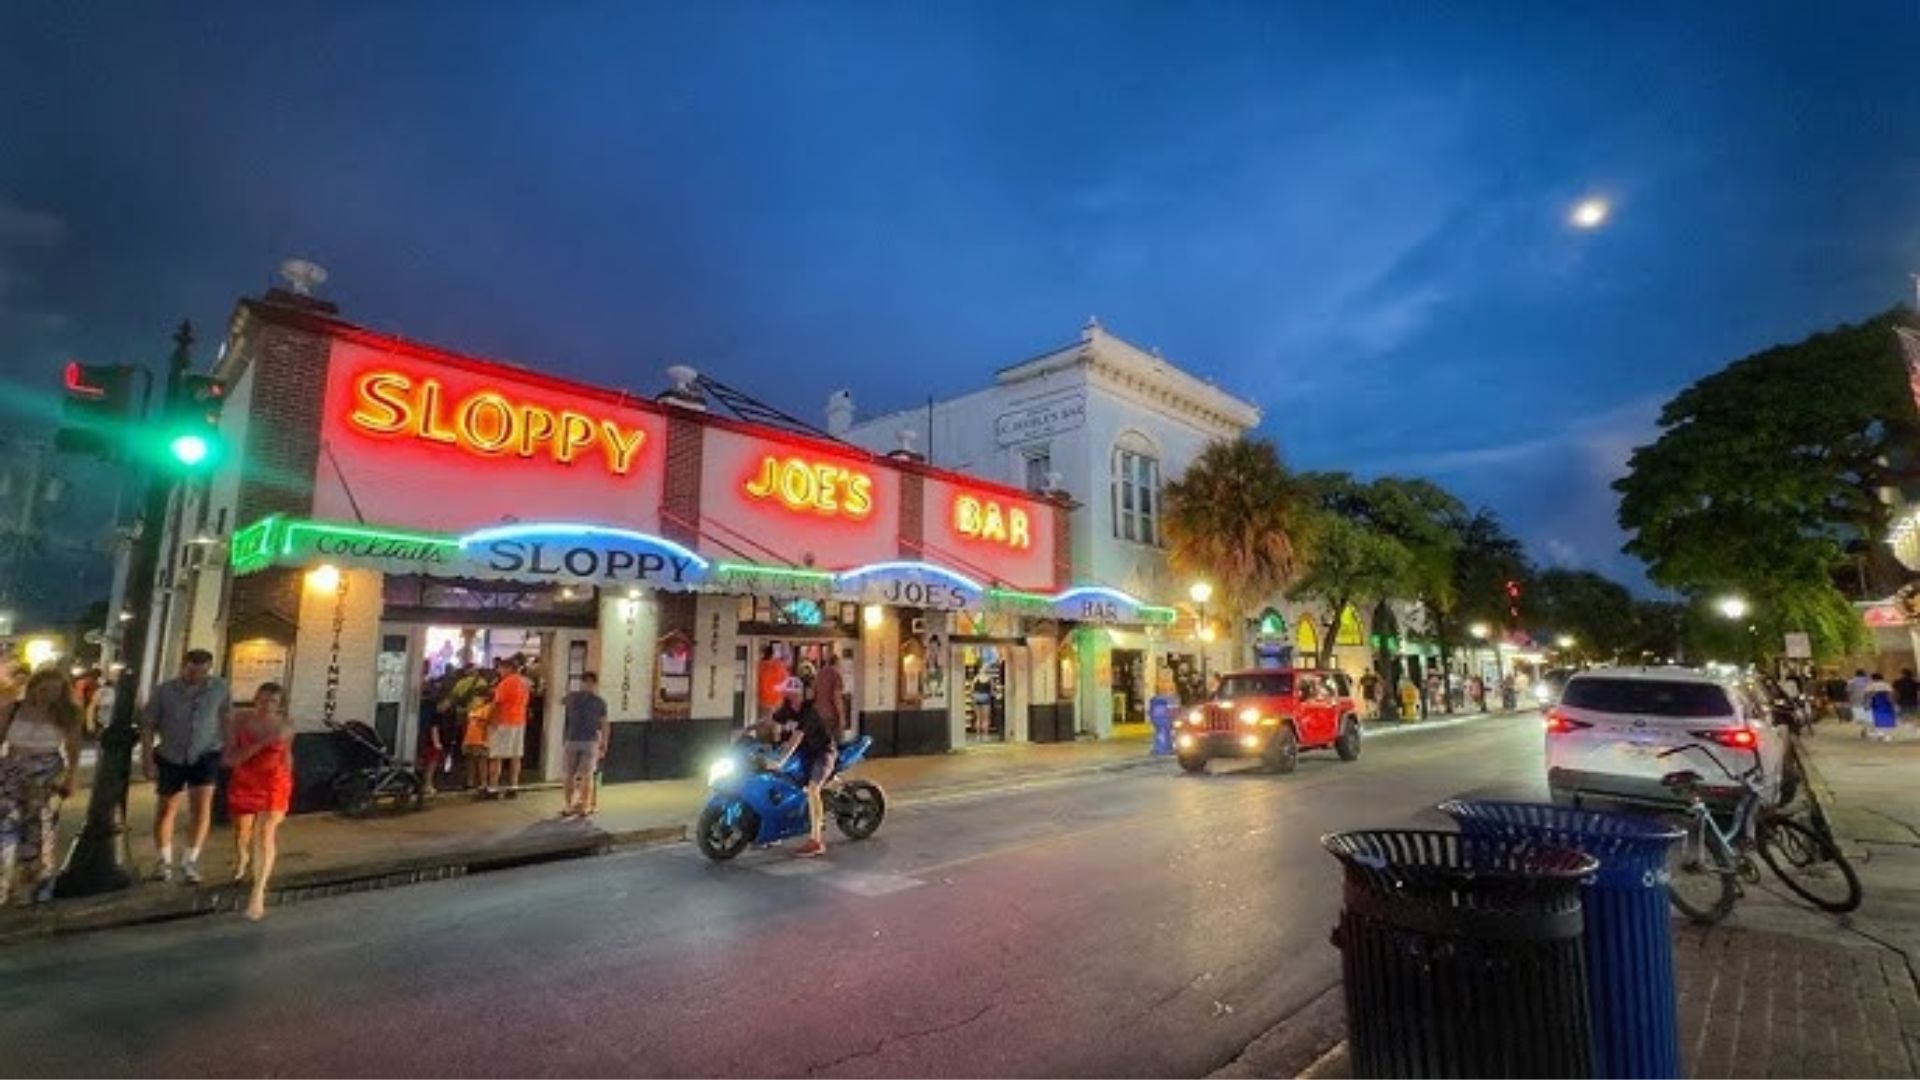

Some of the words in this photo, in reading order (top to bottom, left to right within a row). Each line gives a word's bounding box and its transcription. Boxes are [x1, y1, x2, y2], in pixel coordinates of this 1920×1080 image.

[351, 373, 646, 475] SLOPPY
[746, 456, 872, 514] JOE'S
[954, 495, 1030, 548] BAR
[316, 536, 441, 563] Cocktails
[488, 538, 690, 583] SLOPPY
[883, 579, 967, 608] JOE'S
[1082, 602, 1117, 619] BAR
